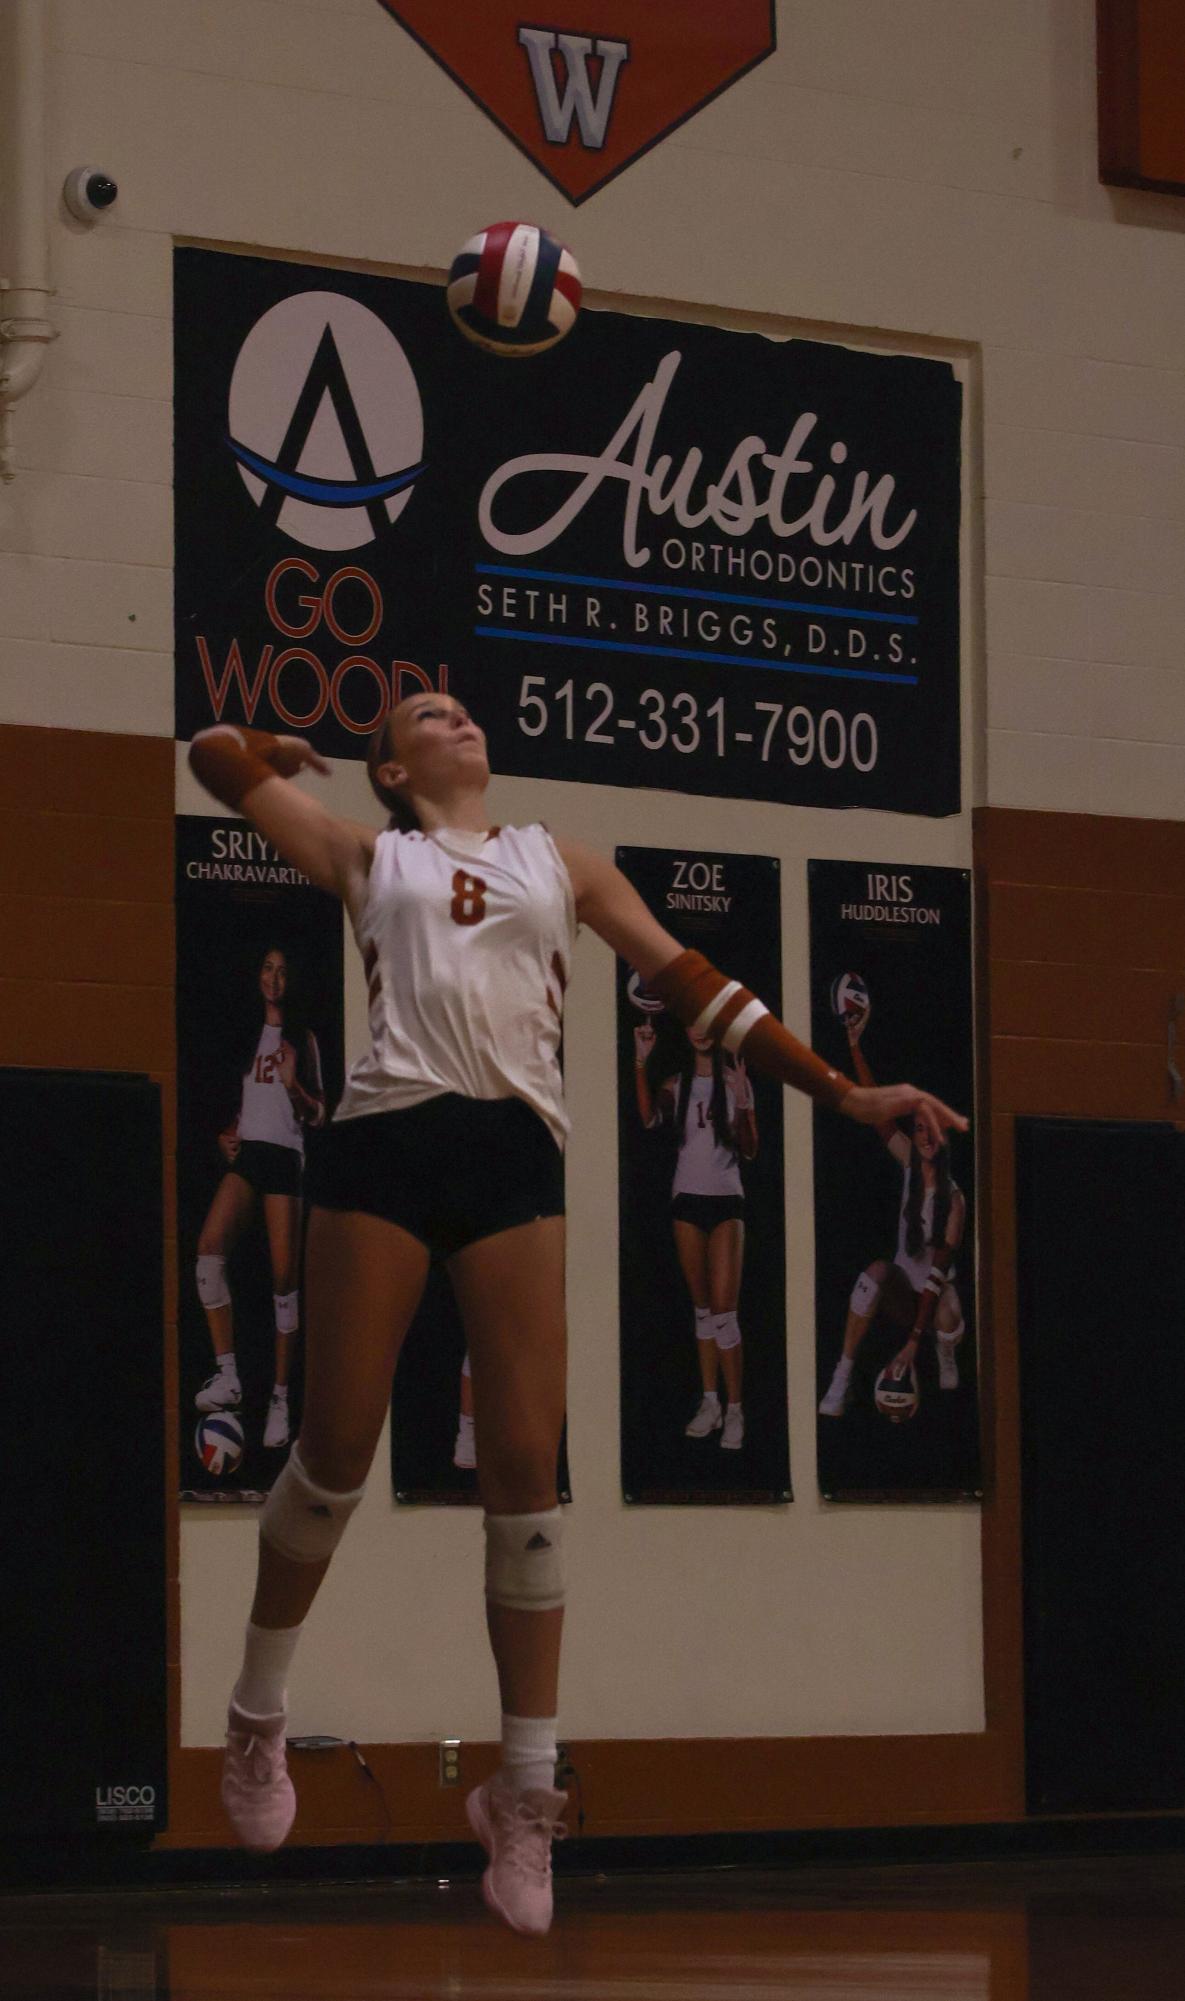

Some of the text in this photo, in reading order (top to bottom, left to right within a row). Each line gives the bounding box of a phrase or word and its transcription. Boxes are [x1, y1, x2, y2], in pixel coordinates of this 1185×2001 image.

[518, 27, 628, 149] W
[478, 349, 918, 569] Austin
[662, 538, 915, 599] ORTHODONTICS
[264, 557, 384, 647] GO
[477, 584, 917, 664] SETH R. BRIGGS, D.D.S.
[518, 675, 878, 772] 512-331-7900
[211, 829, 279, 861] SRIY
[451, 868, 487, 926] 8
[672, 861, 726, 892] ZOE
[867, 873, 914, 903] IRIS
[666, 892, 732, 912] SINITSKY
[841, 903, 940, 925] HUDDLESTON
[255, 1055, 274, 1083] 12
[96, 1785, 156, 1805] LISCO
